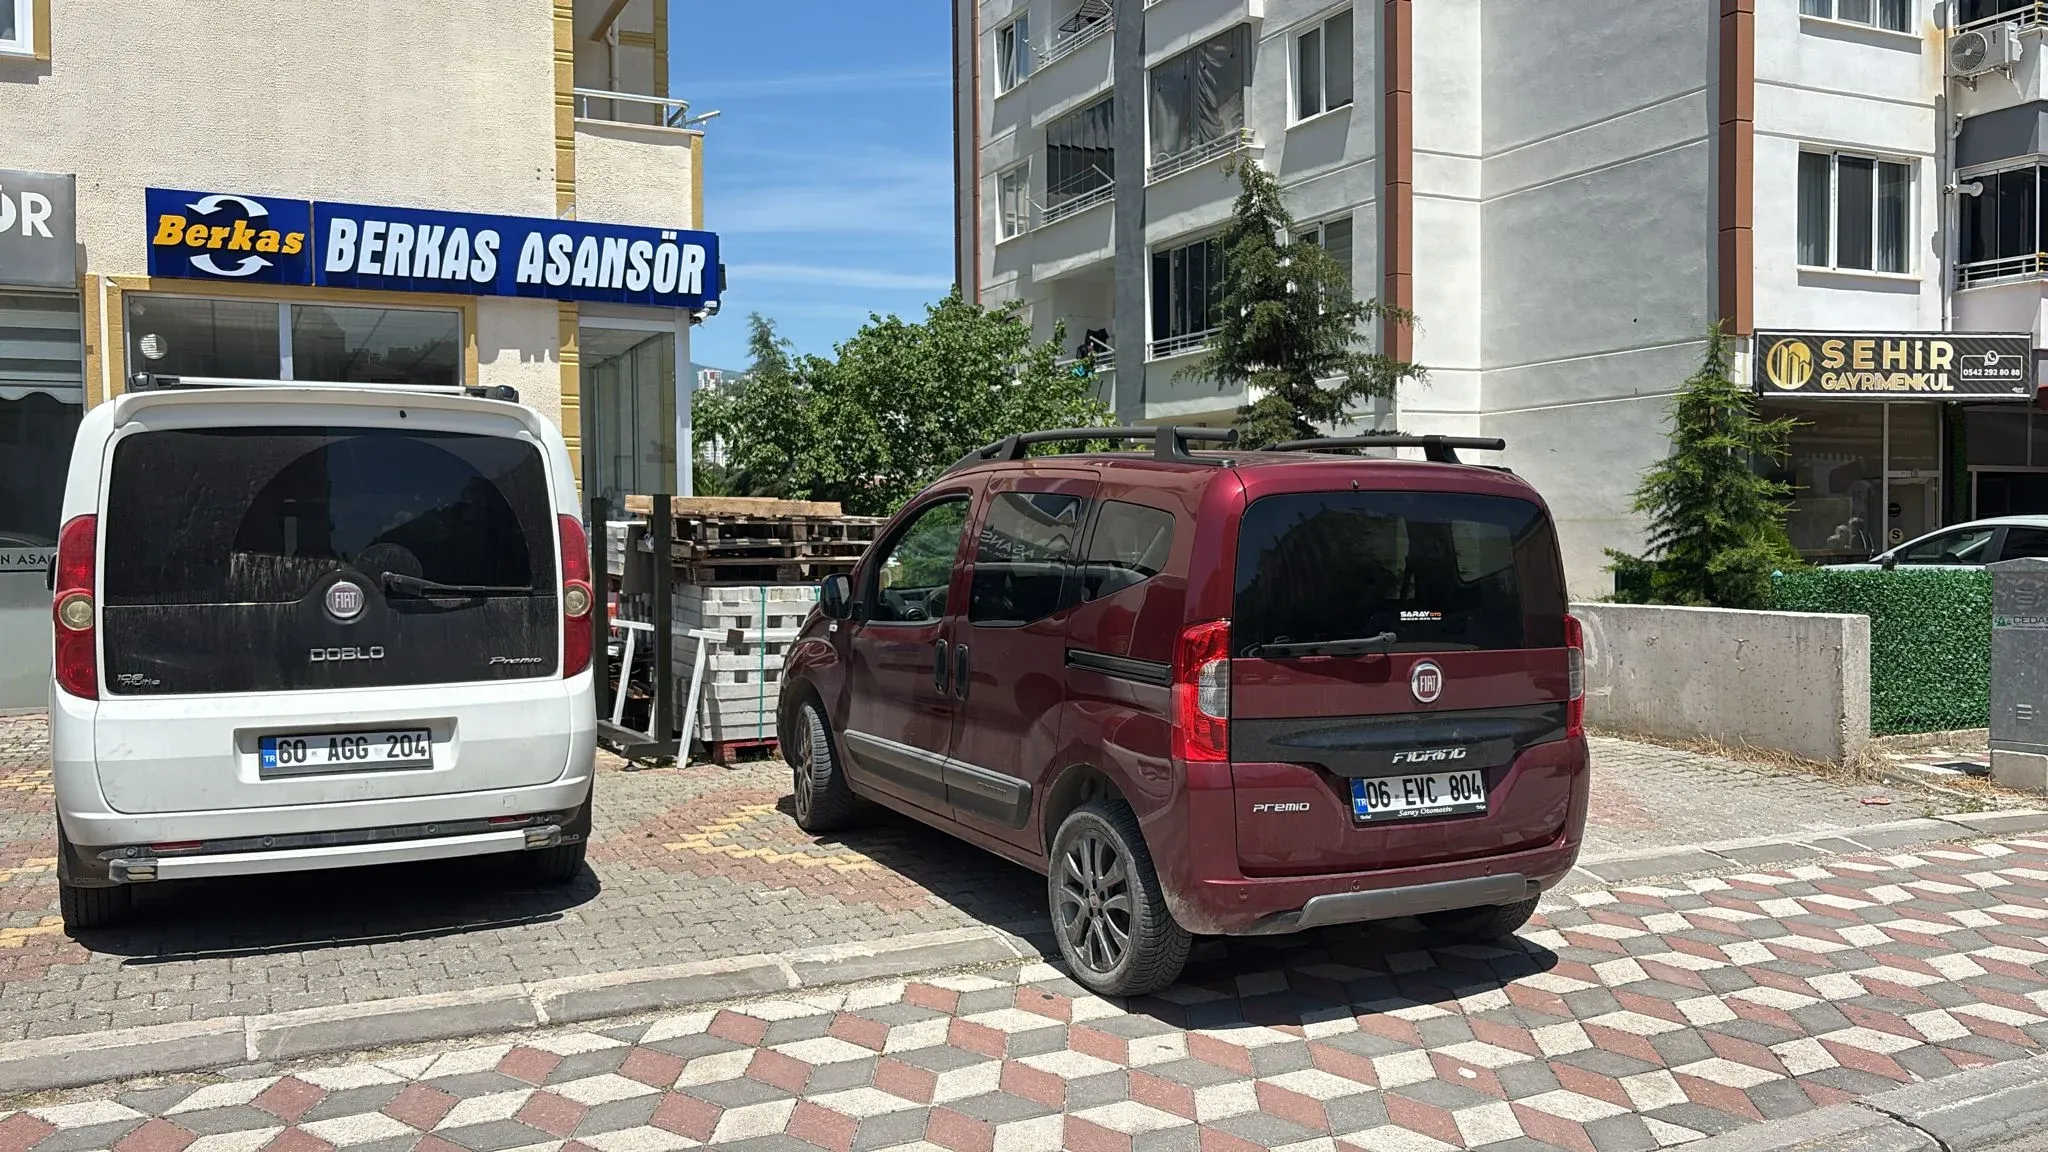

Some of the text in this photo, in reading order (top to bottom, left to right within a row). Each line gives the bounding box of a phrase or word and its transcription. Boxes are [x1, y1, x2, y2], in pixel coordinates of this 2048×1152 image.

[153, 215, 305, 255] Berkas
[325, 217, 706, 295] BERKAS ASANSÖR
[1963, 368, 1983, 376] 0542
[1984, 368, 1998, 376] 292
[1999, 368, 2010, 376] 80
[17, 554, 51, 565] ASA
[334, 592, 356, 608] FIAT
[310, 645, 384, 661] DOBLO
[489, 656, 542, 665] Premio
[1420, 675, 1437, 692] FIAT
[264, 733, 427, 764] TR 60 AGG 204
[1392, 747, 1467, 763] FIORINO
[1357, 773, 1483, 809] TR 06 EVC 804
[1398, 808, 1419, 817] Saray
